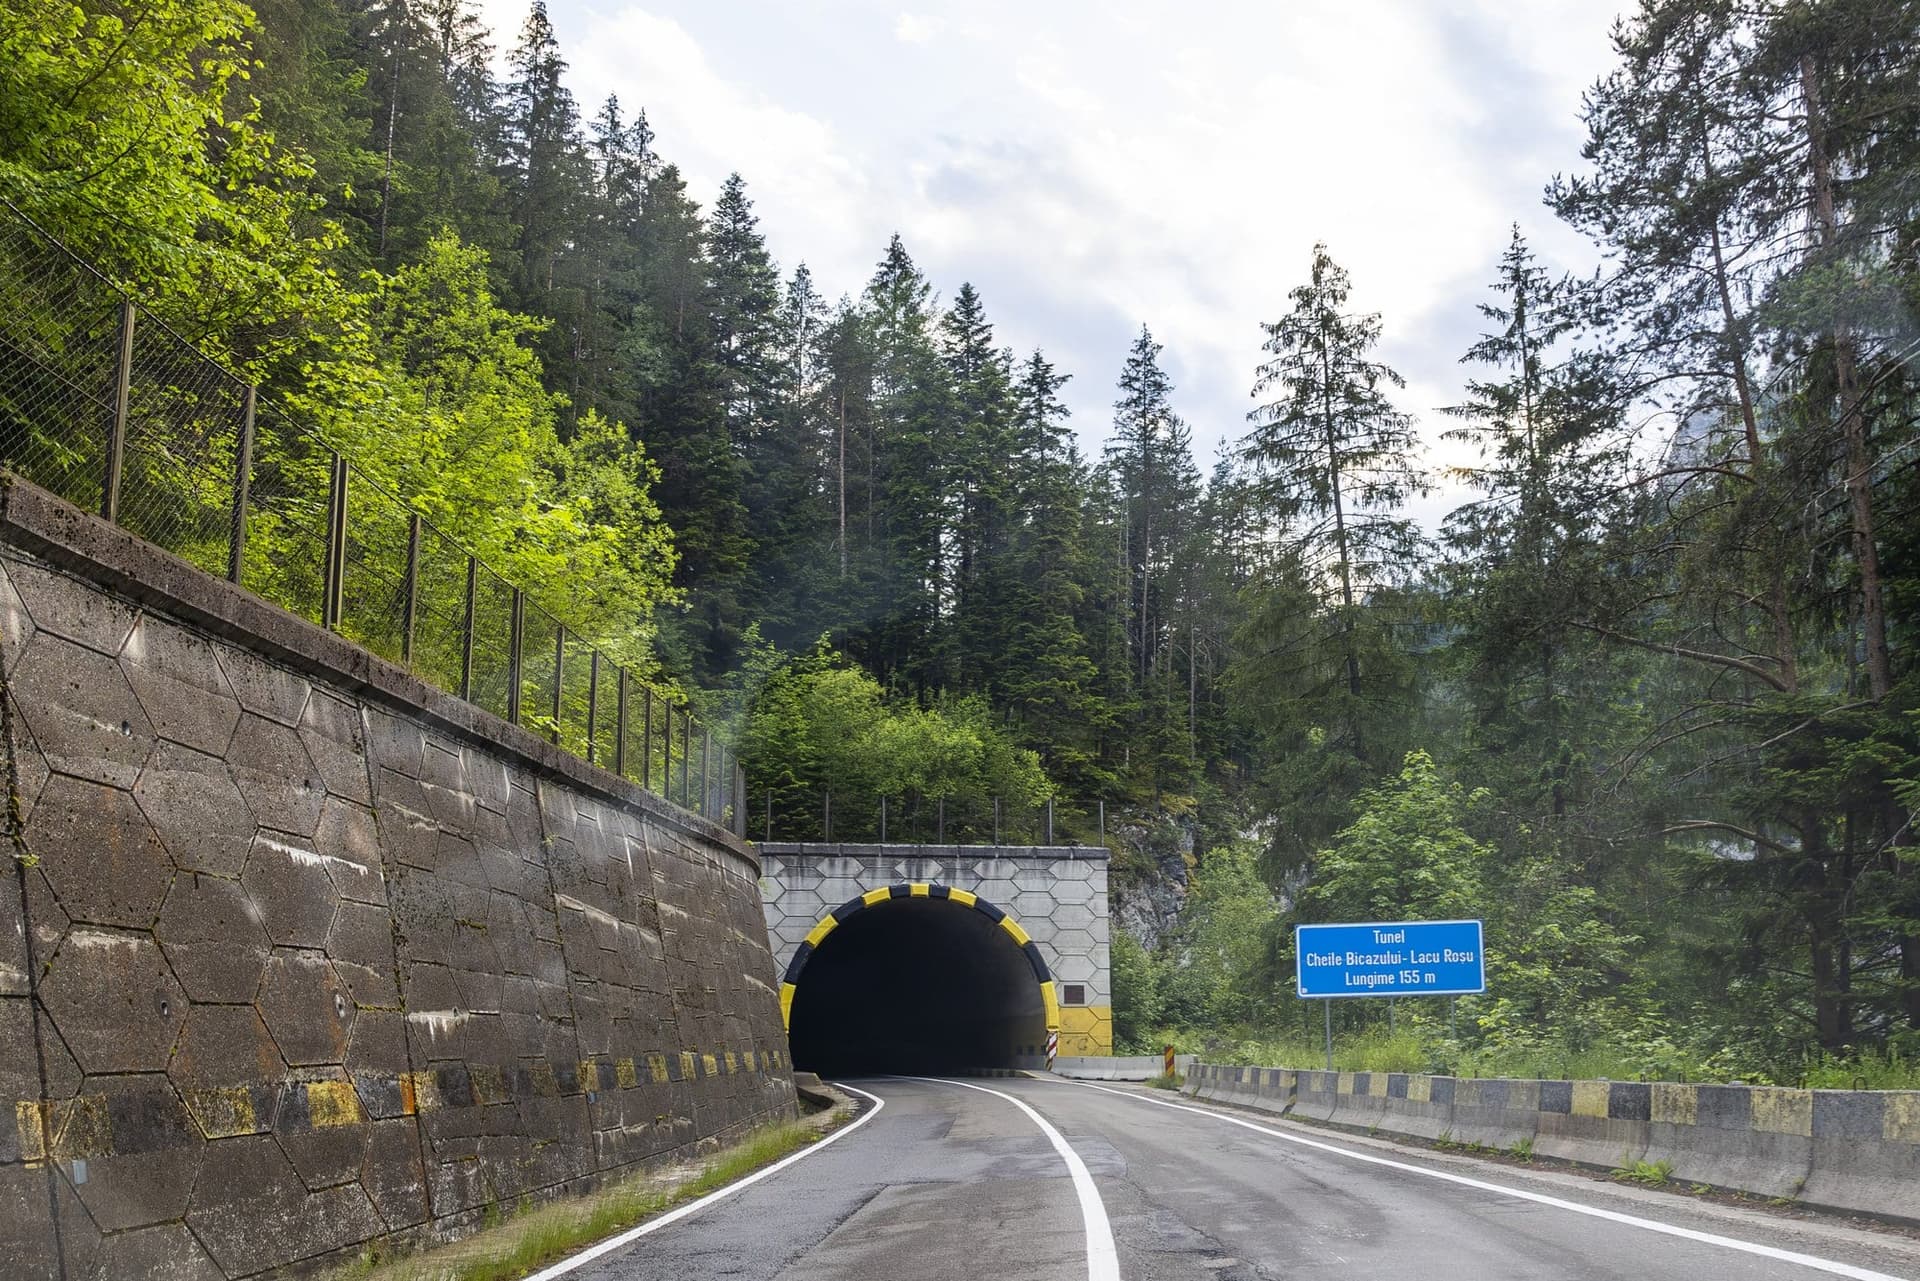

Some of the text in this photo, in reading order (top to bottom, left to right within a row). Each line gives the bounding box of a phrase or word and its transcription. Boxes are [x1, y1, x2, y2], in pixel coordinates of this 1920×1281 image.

[1373, 930, 1405, 944] Tunel
[1306, 952, 1342, 967] Cheile
[1410, 950, 1440, 964] Lacu
[1345, 970, 1436, 988] Lungime 155 m
